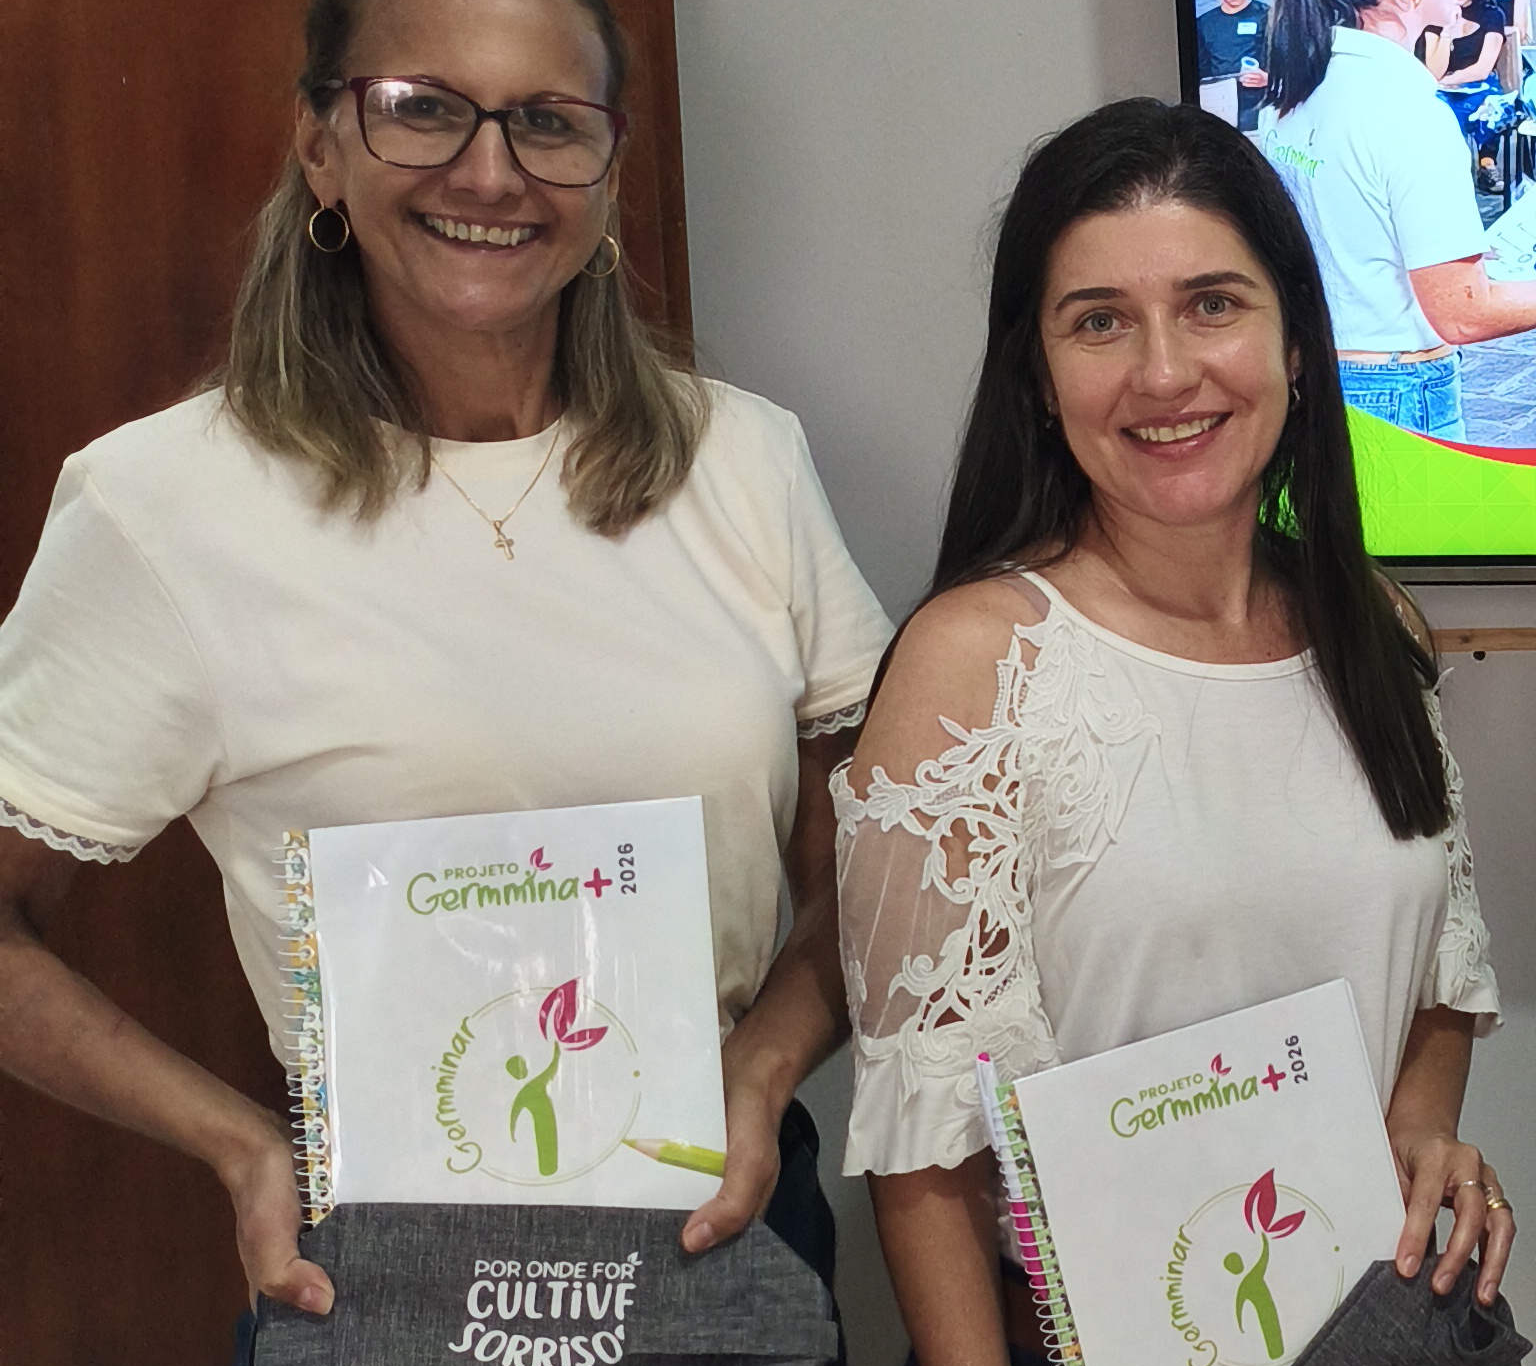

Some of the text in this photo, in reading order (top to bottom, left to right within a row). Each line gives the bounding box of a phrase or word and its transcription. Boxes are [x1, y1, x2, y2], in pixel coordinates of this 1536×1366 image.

[444, 863, 519, 880] PROJETO
[617, 842, 637, 895] 2026
[1285, 1035, 1308, 1084] 2026
[430, 1016, 483, 1174] Germminar
[1139, 1073, 1203, 1102] PROJETO
[474, 1260, 636, 1280] POR ONDE FOR
